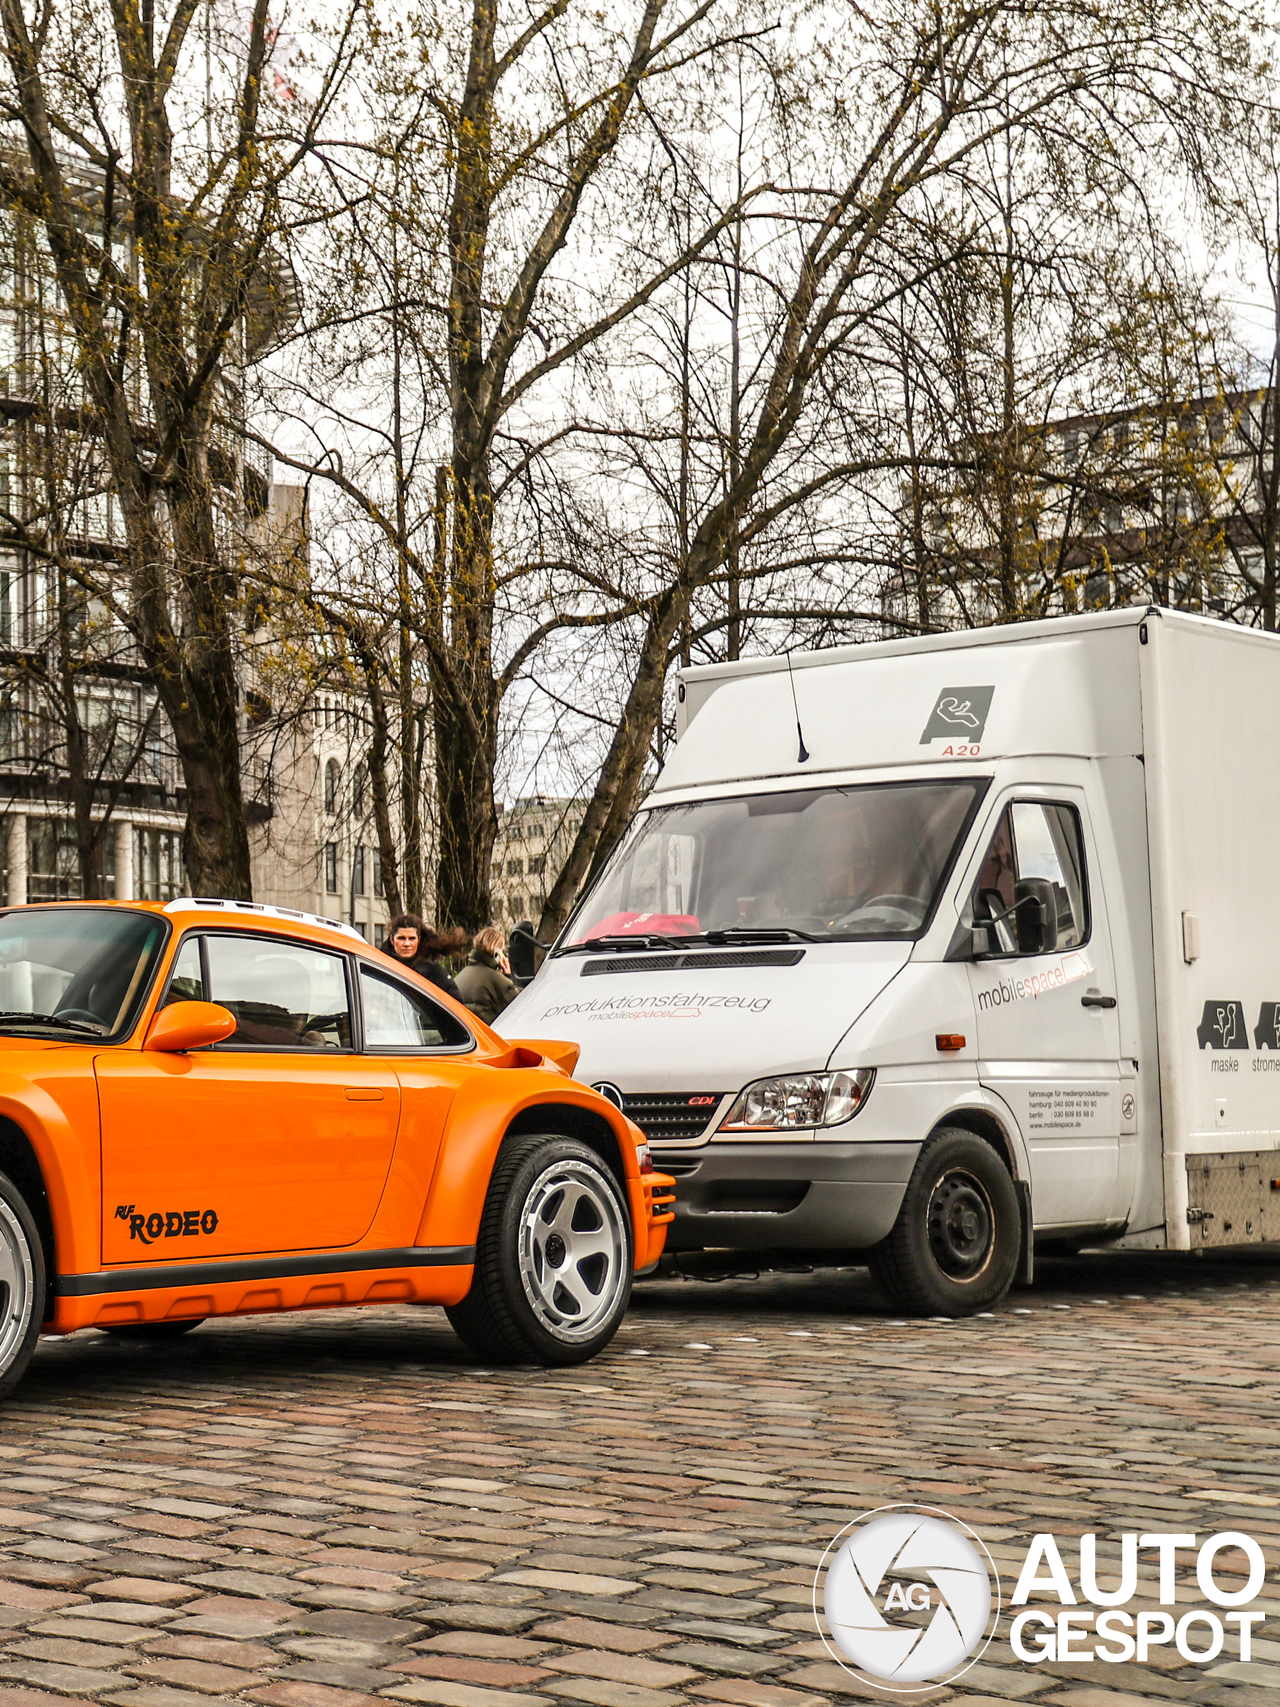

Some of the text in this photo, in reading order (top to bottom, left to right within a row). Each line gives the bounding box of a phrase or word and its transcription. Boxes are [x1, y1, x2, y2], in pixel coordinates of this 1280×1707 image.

[942, 745, 981, 756] A20
[978, 967, 1064, 1011] mobilespace
[540, 993, 771, 1021] produktionsfahrzeug
[587, 1009, 671, 1022] mobilespace
[1211, 1056, 1239, 1072] maske
[688, 1096, 715, 1105] CDI
[1062, 1090, 1109, 1098] medienproduktionen
[1030, 1121, 1081, 1129] www.mobilespace.de
[129, 1210, 219, 1245] RODEO
